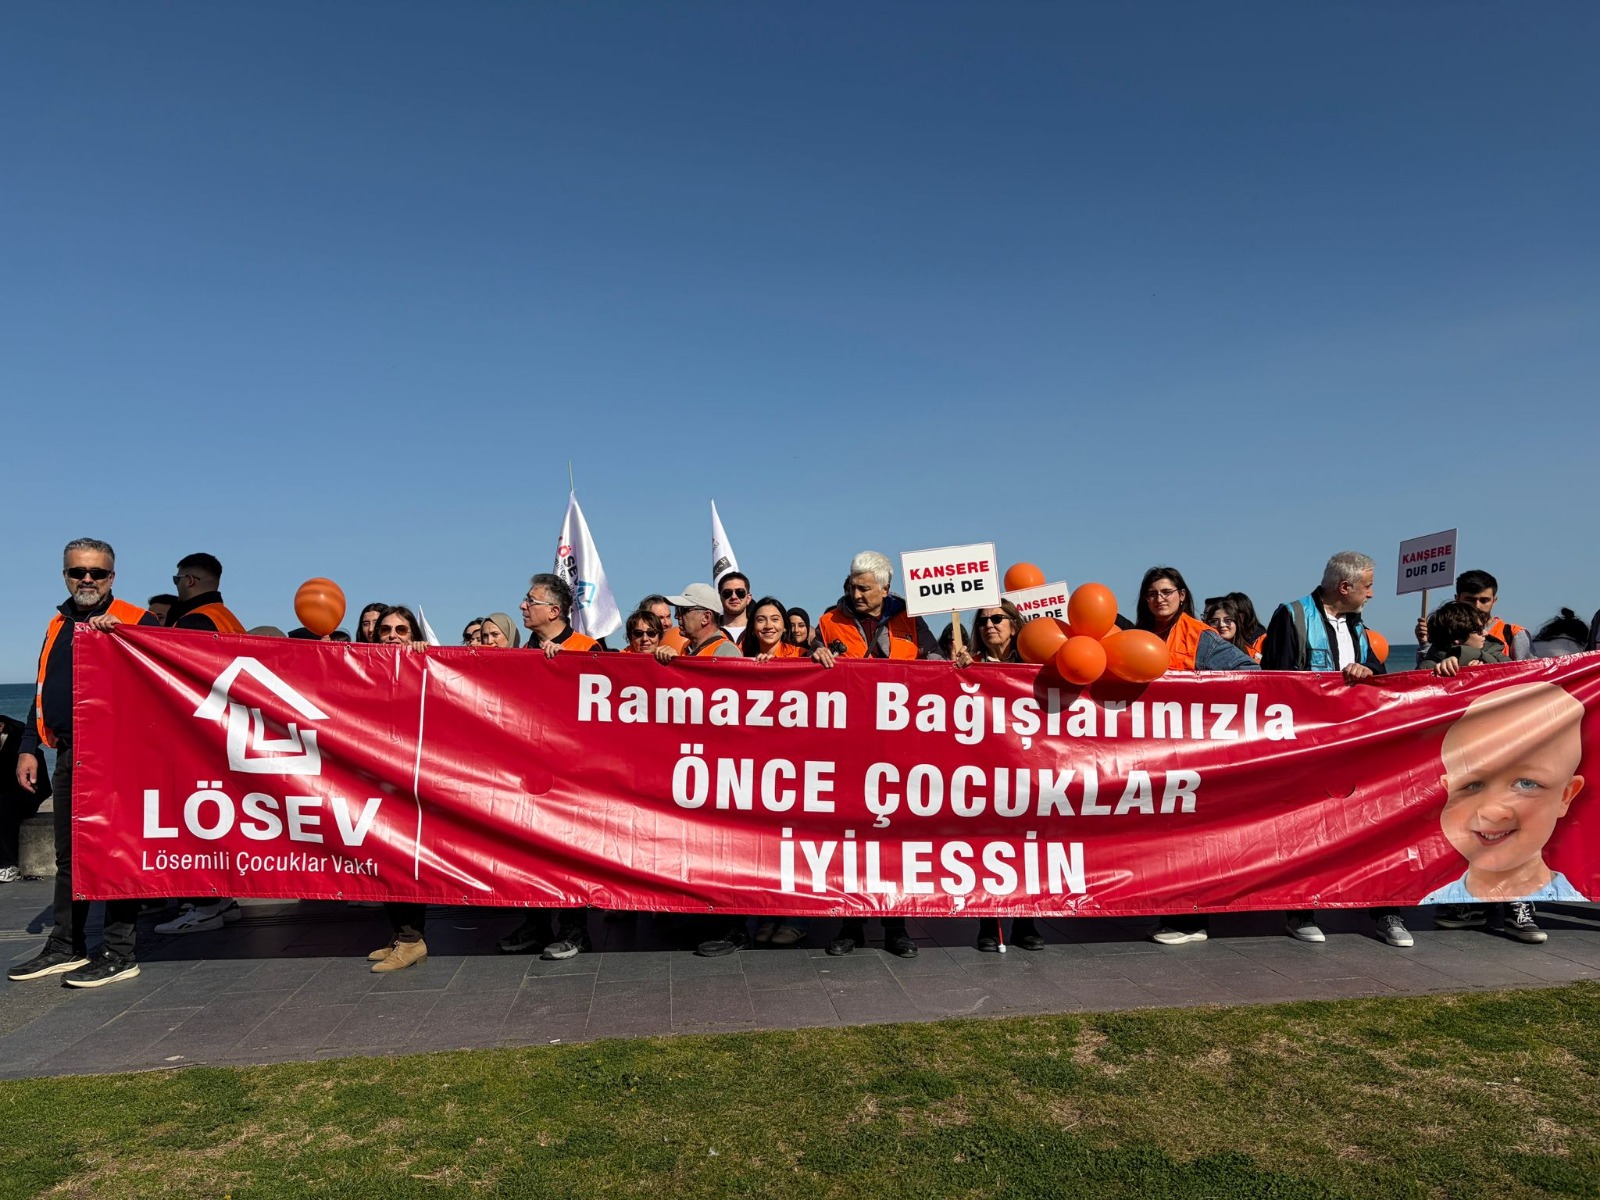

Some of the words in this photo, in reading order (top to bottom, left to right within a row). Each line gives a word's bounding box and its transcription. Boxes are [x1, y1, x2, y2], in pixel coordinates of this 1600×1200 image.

[1402, 545, 1452, 564] KANSERE
[910, 561, 990, 580] KANSERE
[1406, 565, 1428, 578] DUR
[1431, 561, 1446, 574] DE
[919, 582, 955, 597] DUR
[961, 579, 984, 592] DE
[1016, 595, 1066, 612] ANSERE
[1045, 609, 1063, 618] DE
[577, 673, 847, 729] Ramazan
[876, 682, 1297, 749] Bağışlarınızla
[671, 743, 836, 813] ÖNCE
[863, 762, 1202, 828] ÇOCUKLAR
[143, 780, 382, 847] LÖSEV
[142, 850, 230, 871] Lösemili
[236, 851, 328, 876] Çocuklar
[331, 855, 378, 877] Vakfı
[779, 827, 1087, 911] İYİLEŞSİN
